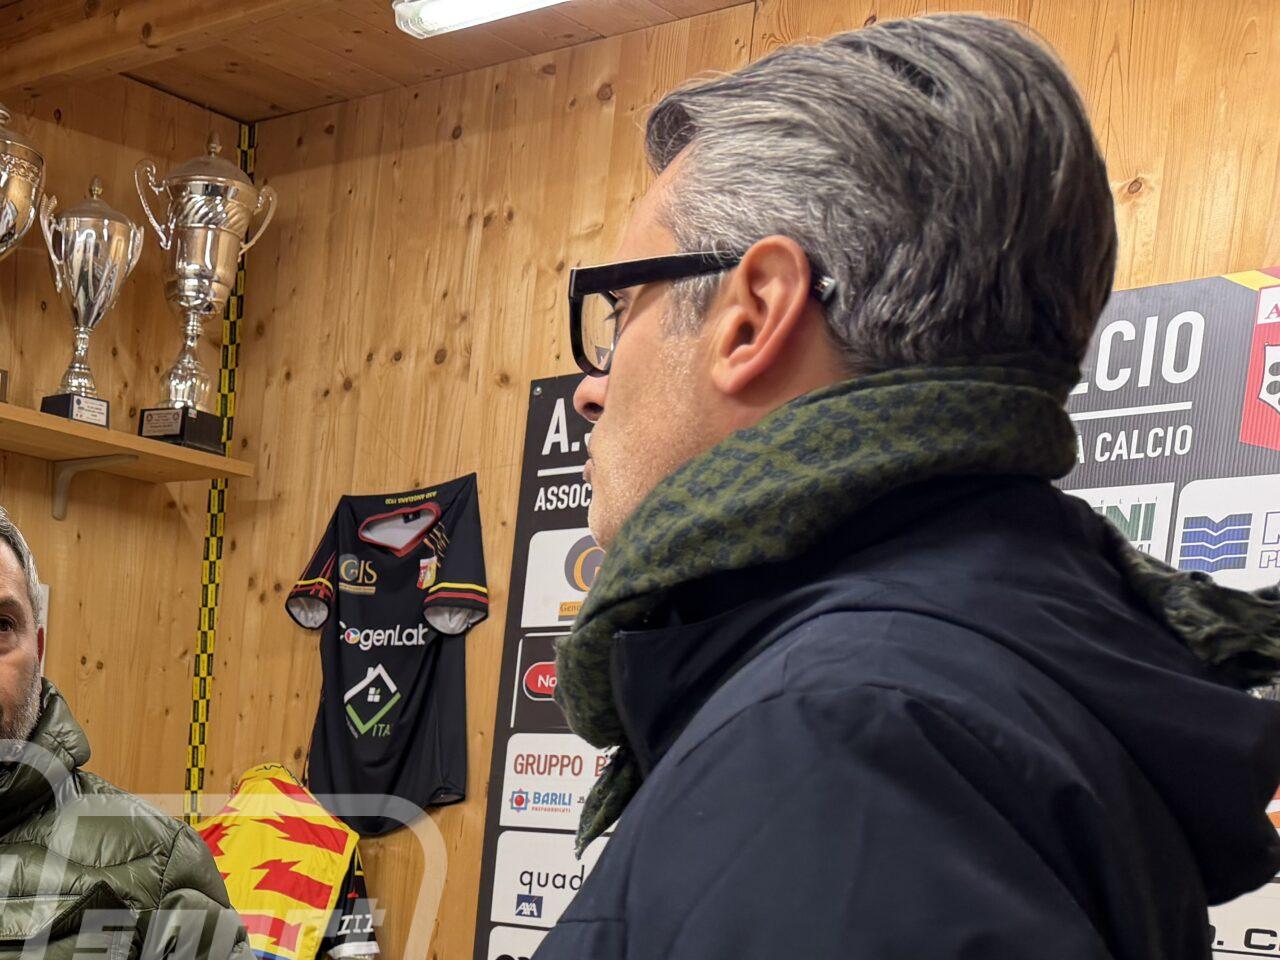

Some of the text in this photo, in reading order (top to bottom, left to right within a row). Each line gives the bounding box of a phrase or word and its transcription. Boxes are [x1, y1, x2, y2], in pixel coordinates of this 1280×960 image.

[1070, 310, 1206, 396] CIO
[1094, 424, 1193, 463] CALCIO
[1092, 503, 1157, 542] NI
[340, 559, 378, 584] GIS
[513, 753, 584, 777] GRUPPO
[533, 791, 572, 806] BARILI
[515, 901, 538, 917] AXA
